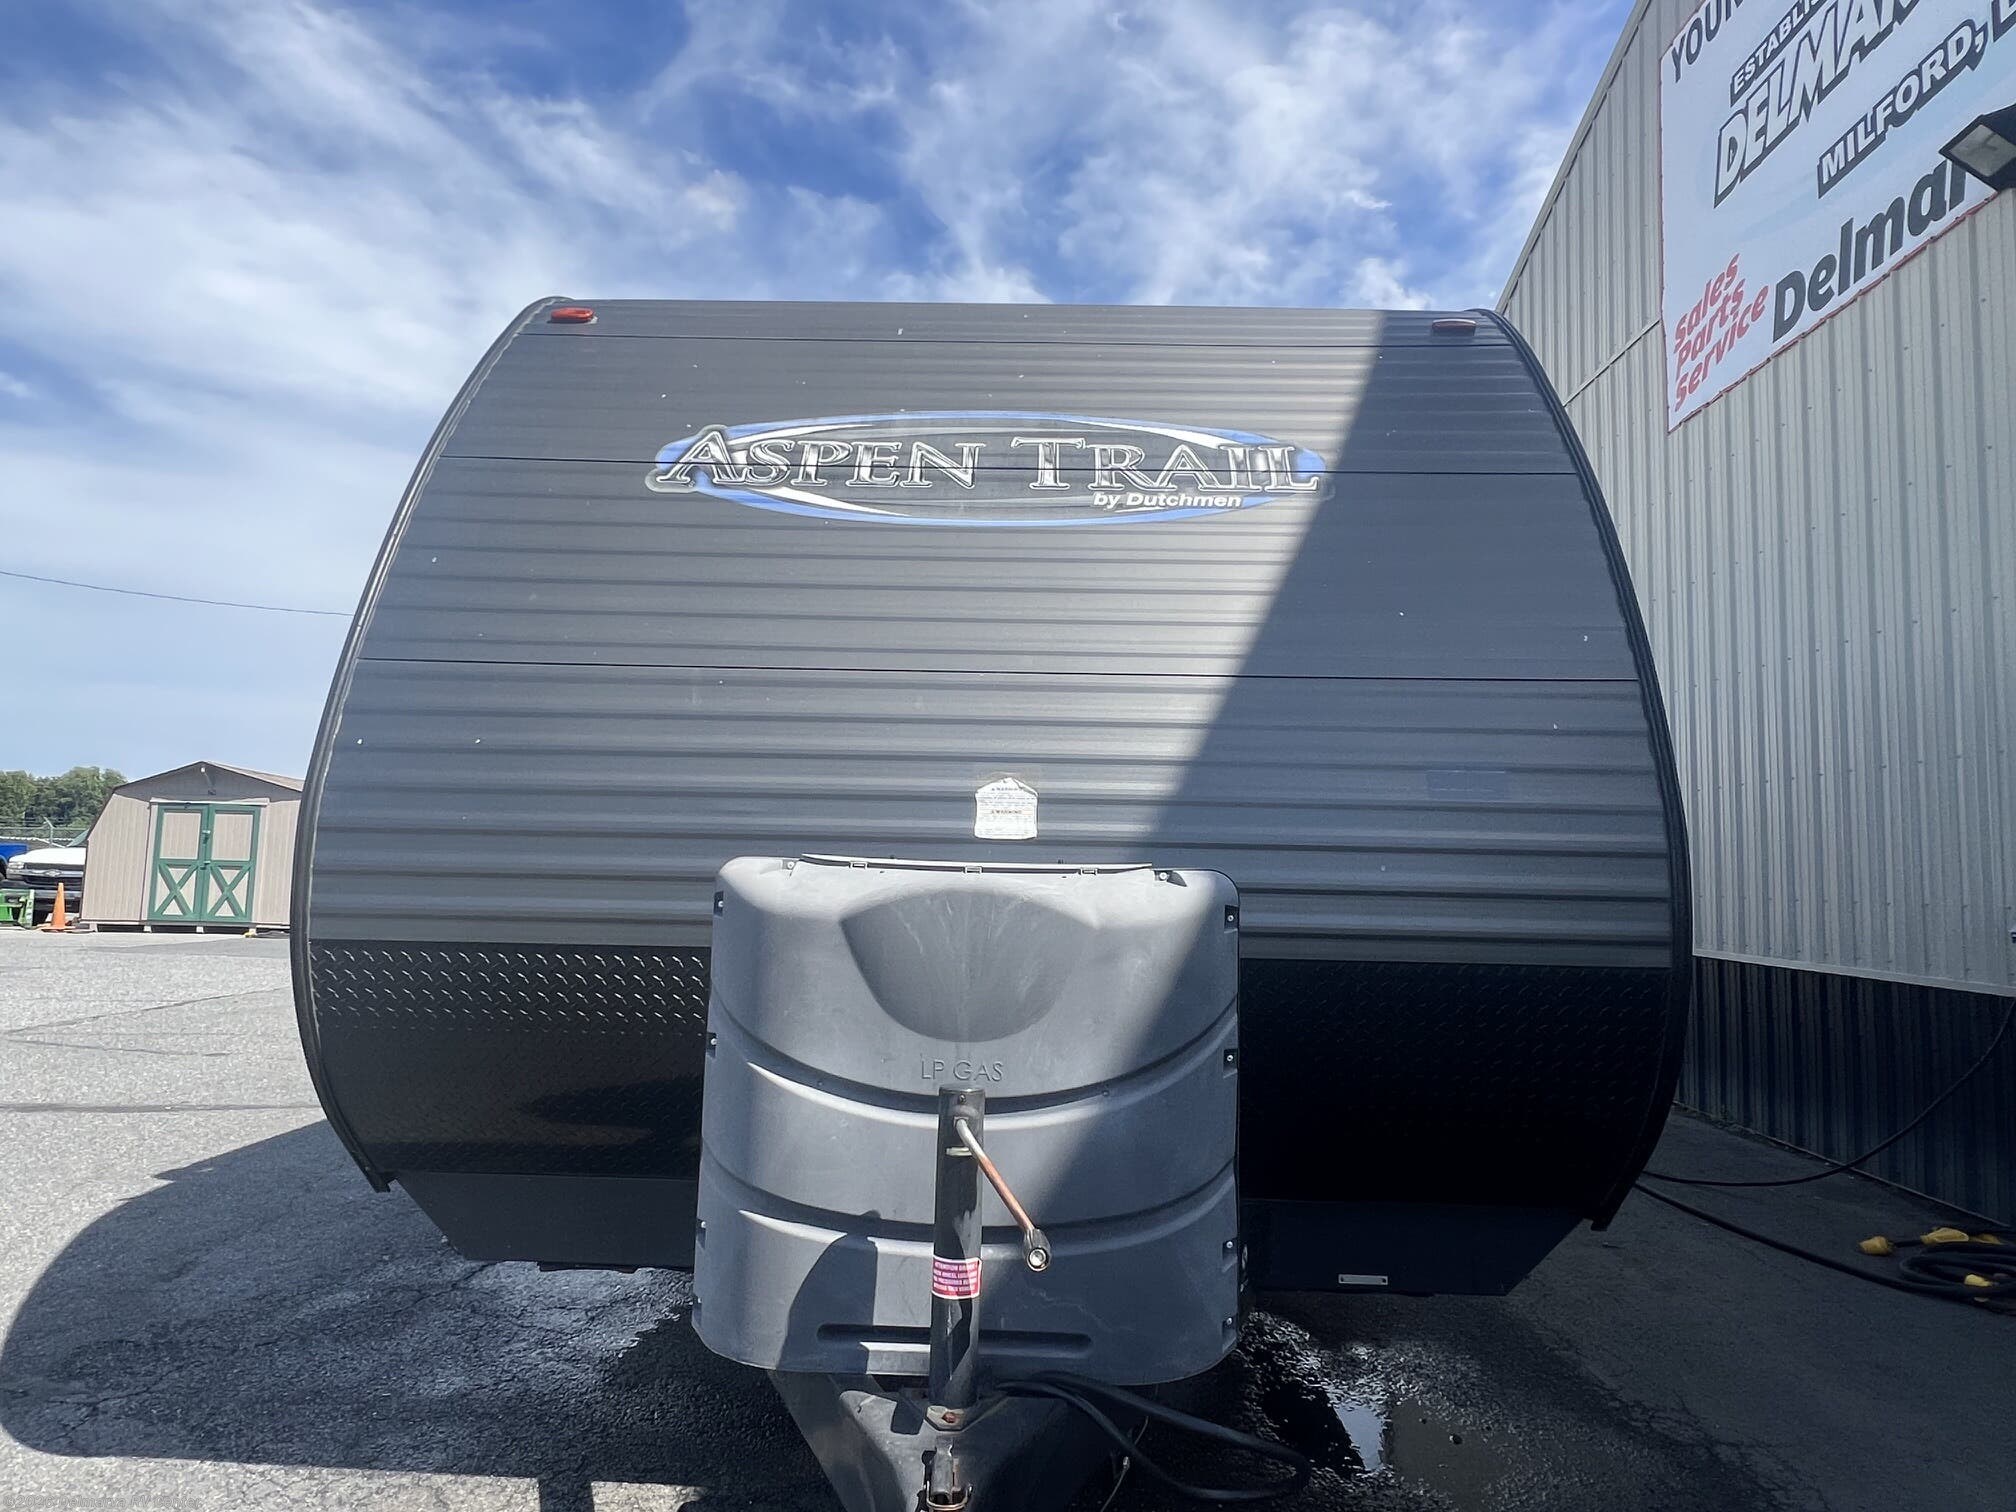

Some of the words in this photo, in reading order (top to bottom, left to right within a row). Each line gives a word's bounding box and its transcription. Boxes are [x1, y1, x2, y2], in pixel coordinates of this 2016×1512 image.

[1817, 19, 1989, 199] MILFORD,
[1674, 253, 1740, 354] sales
[1674, 285, 1769, 412] service
[1675, 278, 1746, 378] parts
[655, 430, 986, 489] ASPEN
[1010, 436, 1320, 492] TRAIL
[1093, 492, 1116, 513] by
[1126, 492, 1243, 508] Dutchmen
[921, 1059, 945, 1080] LP
[952, 1059, 1004, 1082] GAS
